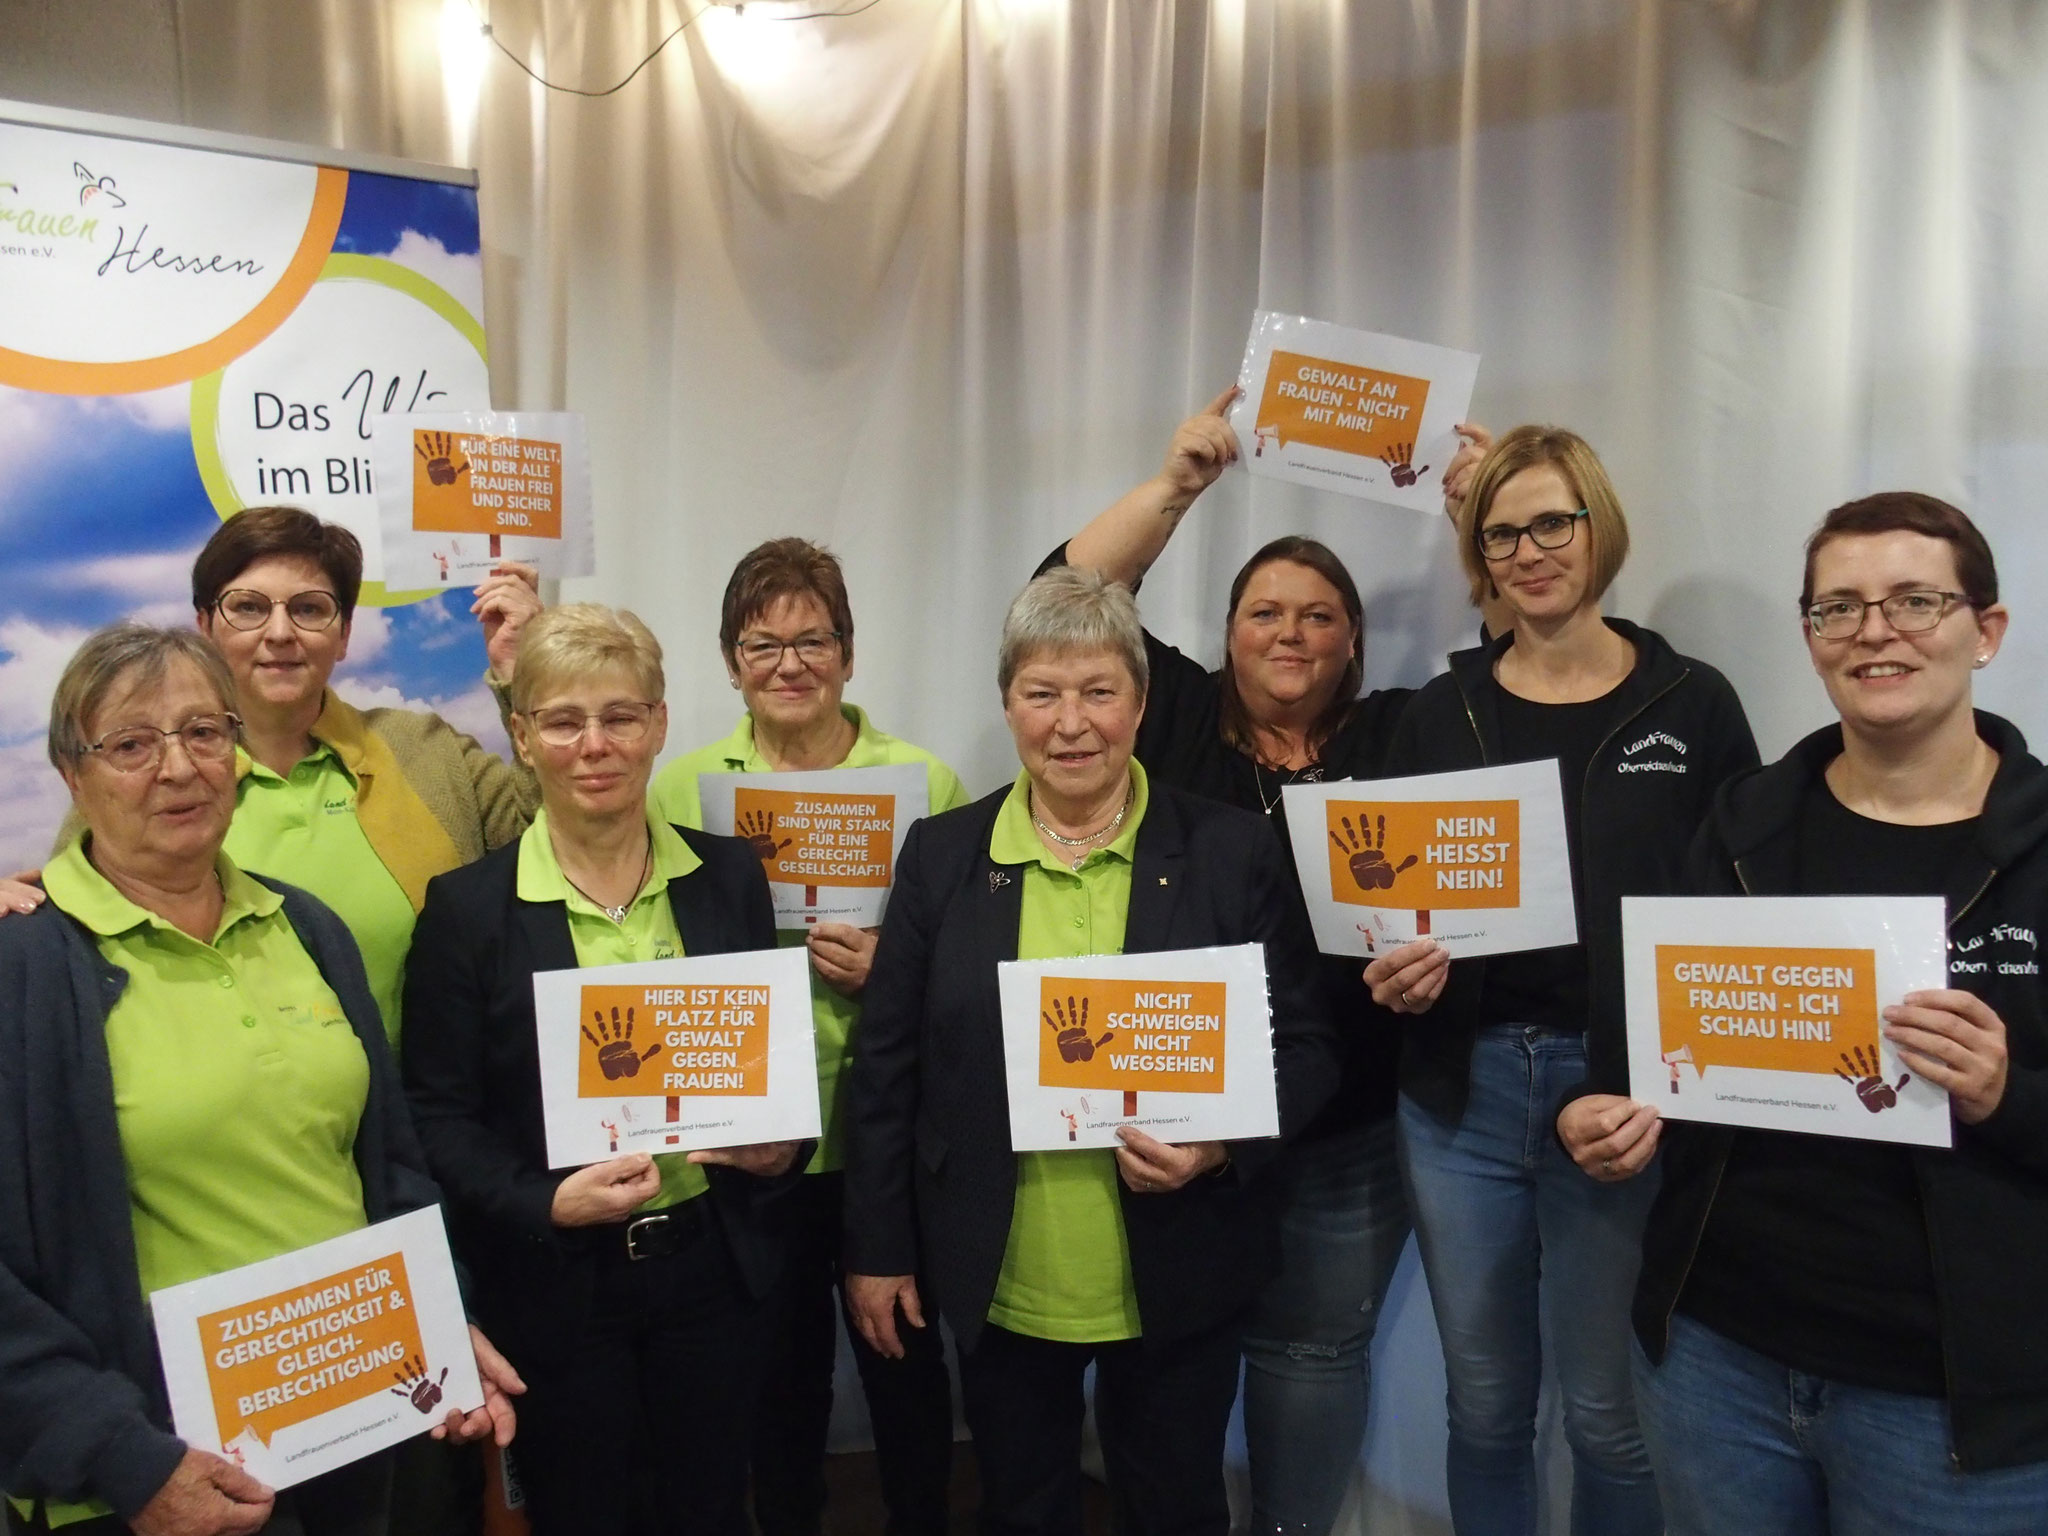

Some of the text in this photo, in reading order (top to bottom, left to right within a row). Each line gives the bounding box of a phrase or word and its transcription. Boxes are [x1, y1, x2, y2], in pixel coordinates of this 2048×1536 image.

[0, 183, 99, 243] rauen
[0, 245, 56, 259] sen e.V.
[98, 224, 264, 276] Hessen
[1298, 366, 1397, 399] GEWALT AN
[1277, 382, 1343, 407] FRAUEN
[1357, 397, 1409, 420] NICHT
[254, 392, 331, 431] Das
[1303, 406, 1373, 433] MIT MIR!
[491, 442, 521, 459] EINE
[258, 457, 372, 495] im Bli
[492, 461, 518, 475] DER
[521, 465, 551, 478] ALLE
[470, 475, 554, 496] FRAUEN FREI
[472, 493, 552, 512] UND SICHER
[497, 512, 533, 528] SIND.
[794, 801, 876, 816] ZUSAMMEN
[777, 816, 892, 832] SIND WIR STARK
[1436, 817, 1496, 838] NEIN
[808, 831, 835, 847] FÜR
[839, 834, 869, 847] EINE
[798, 848, 868, 862] GERECHTE
[1425, 843, 1511, 864] HEISST
[778, 861, 886, 877] GESELLSCHAFT!
[1436, 868, 1504, 890] NEIN!
[1446, 932, 1472, 941] Hessen
[1674, 962, 1854, 988] GEWALT GEGEN
[644, 989, 768, 1006] HIER IST KEIN
[1134, 993, 1193, 1010] NICHT
[1688, 989, 1777, 1012] FRAUEN
[1798, 994, 1839, 1016] ICH
[655, 1006, 756, 1027] PLATZ FÜR
[1106, 1012, 1220, 1031] SCHWEIGEN
[1699, 1015, 1832, 1042] SCHAU HIN!
[665, 1031, 745, 1048] GEWALT
[1133, 1034, 1192, 1052] NICHT
[672, 1052, 737, 1068] GEGEN
[1109, 1054, 1215, 1073] WEGSEHEN
[663, 1072, 745, 1090] FRAUEN!
[1791, 1099, 1822, 1111] Hessen
[695, 1120, 721, 1131] Hessen
[1086, 1115, 1192, 1130] Landfrauenverband Hessen e.V.
[219, 1268, 394, 1343] ZUSAMMEN FÜR
[215, 1290, 406, 1370] GERECHTIGKEIT &
[276, 1335, 364, 1377] GLEICH-
[238, 1340, 405, 1417] BERECHTIGUNG
